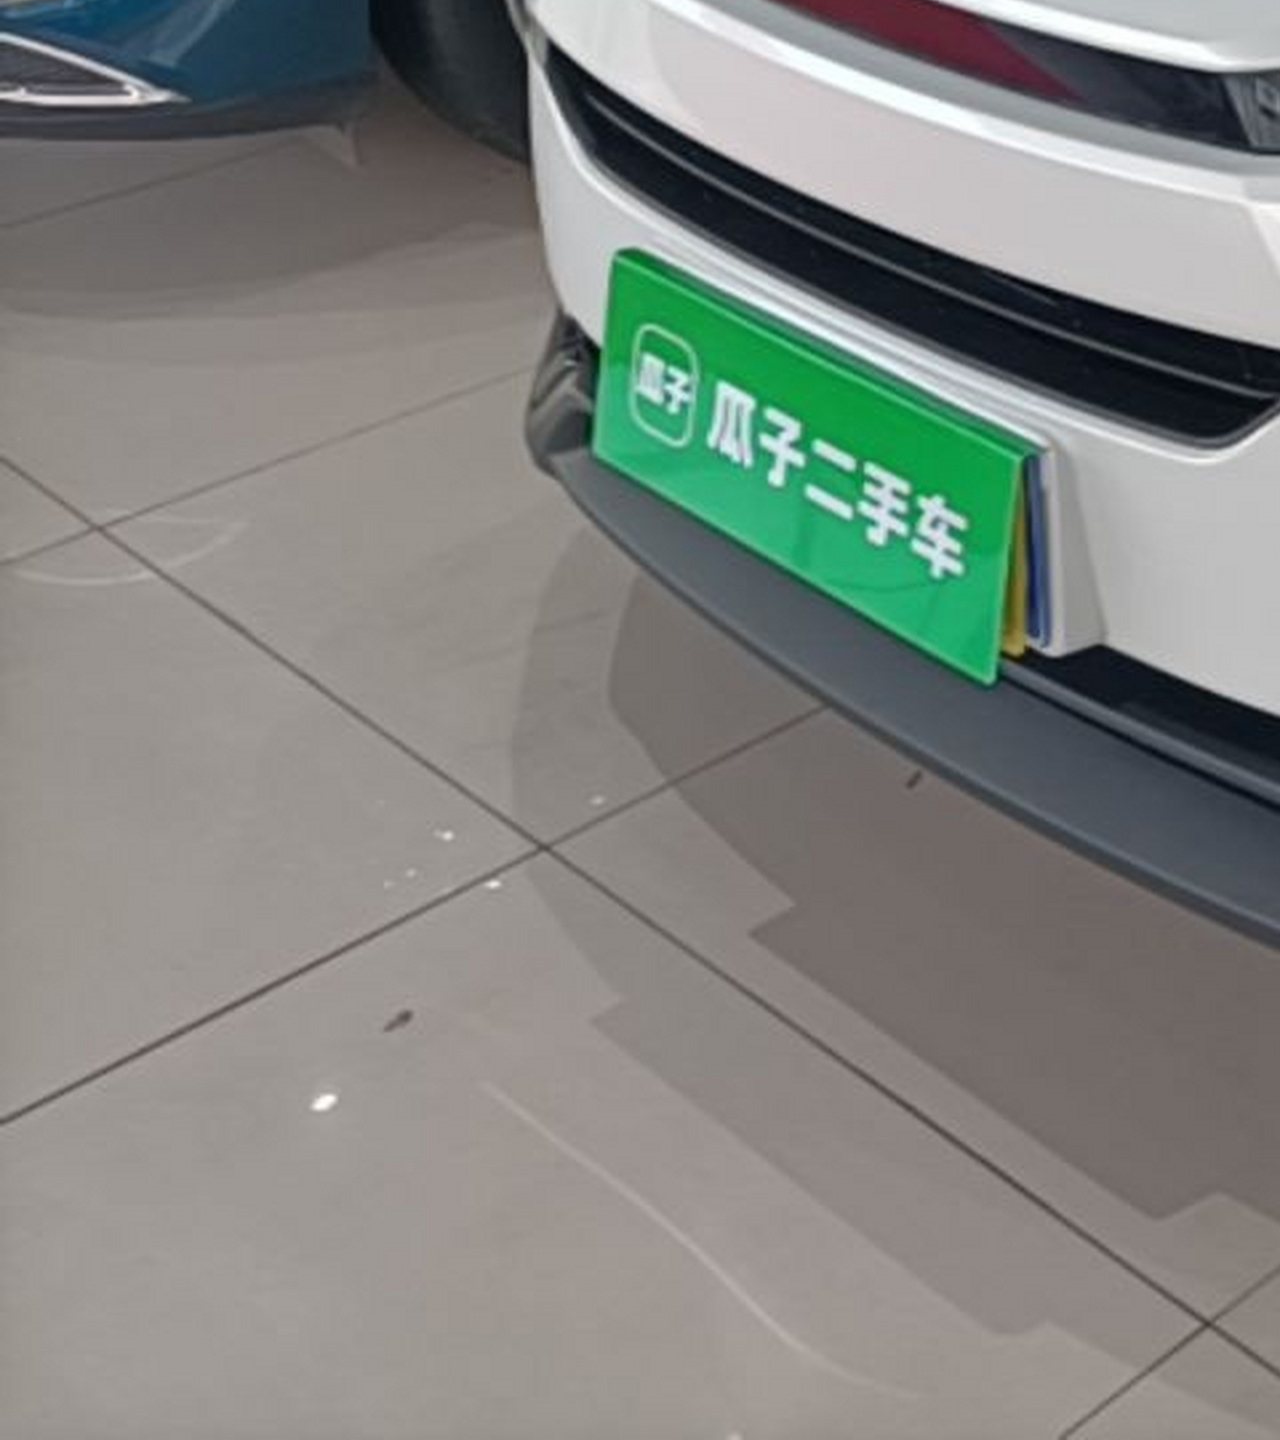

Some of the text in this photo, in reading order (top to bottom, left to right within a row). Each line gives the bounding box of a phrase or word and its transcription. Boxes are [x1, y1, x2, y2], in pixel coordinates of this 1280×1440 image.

[634, 351, 693, 415] 瓜子
[706, 378, 968, 579] 瓜子二手车
